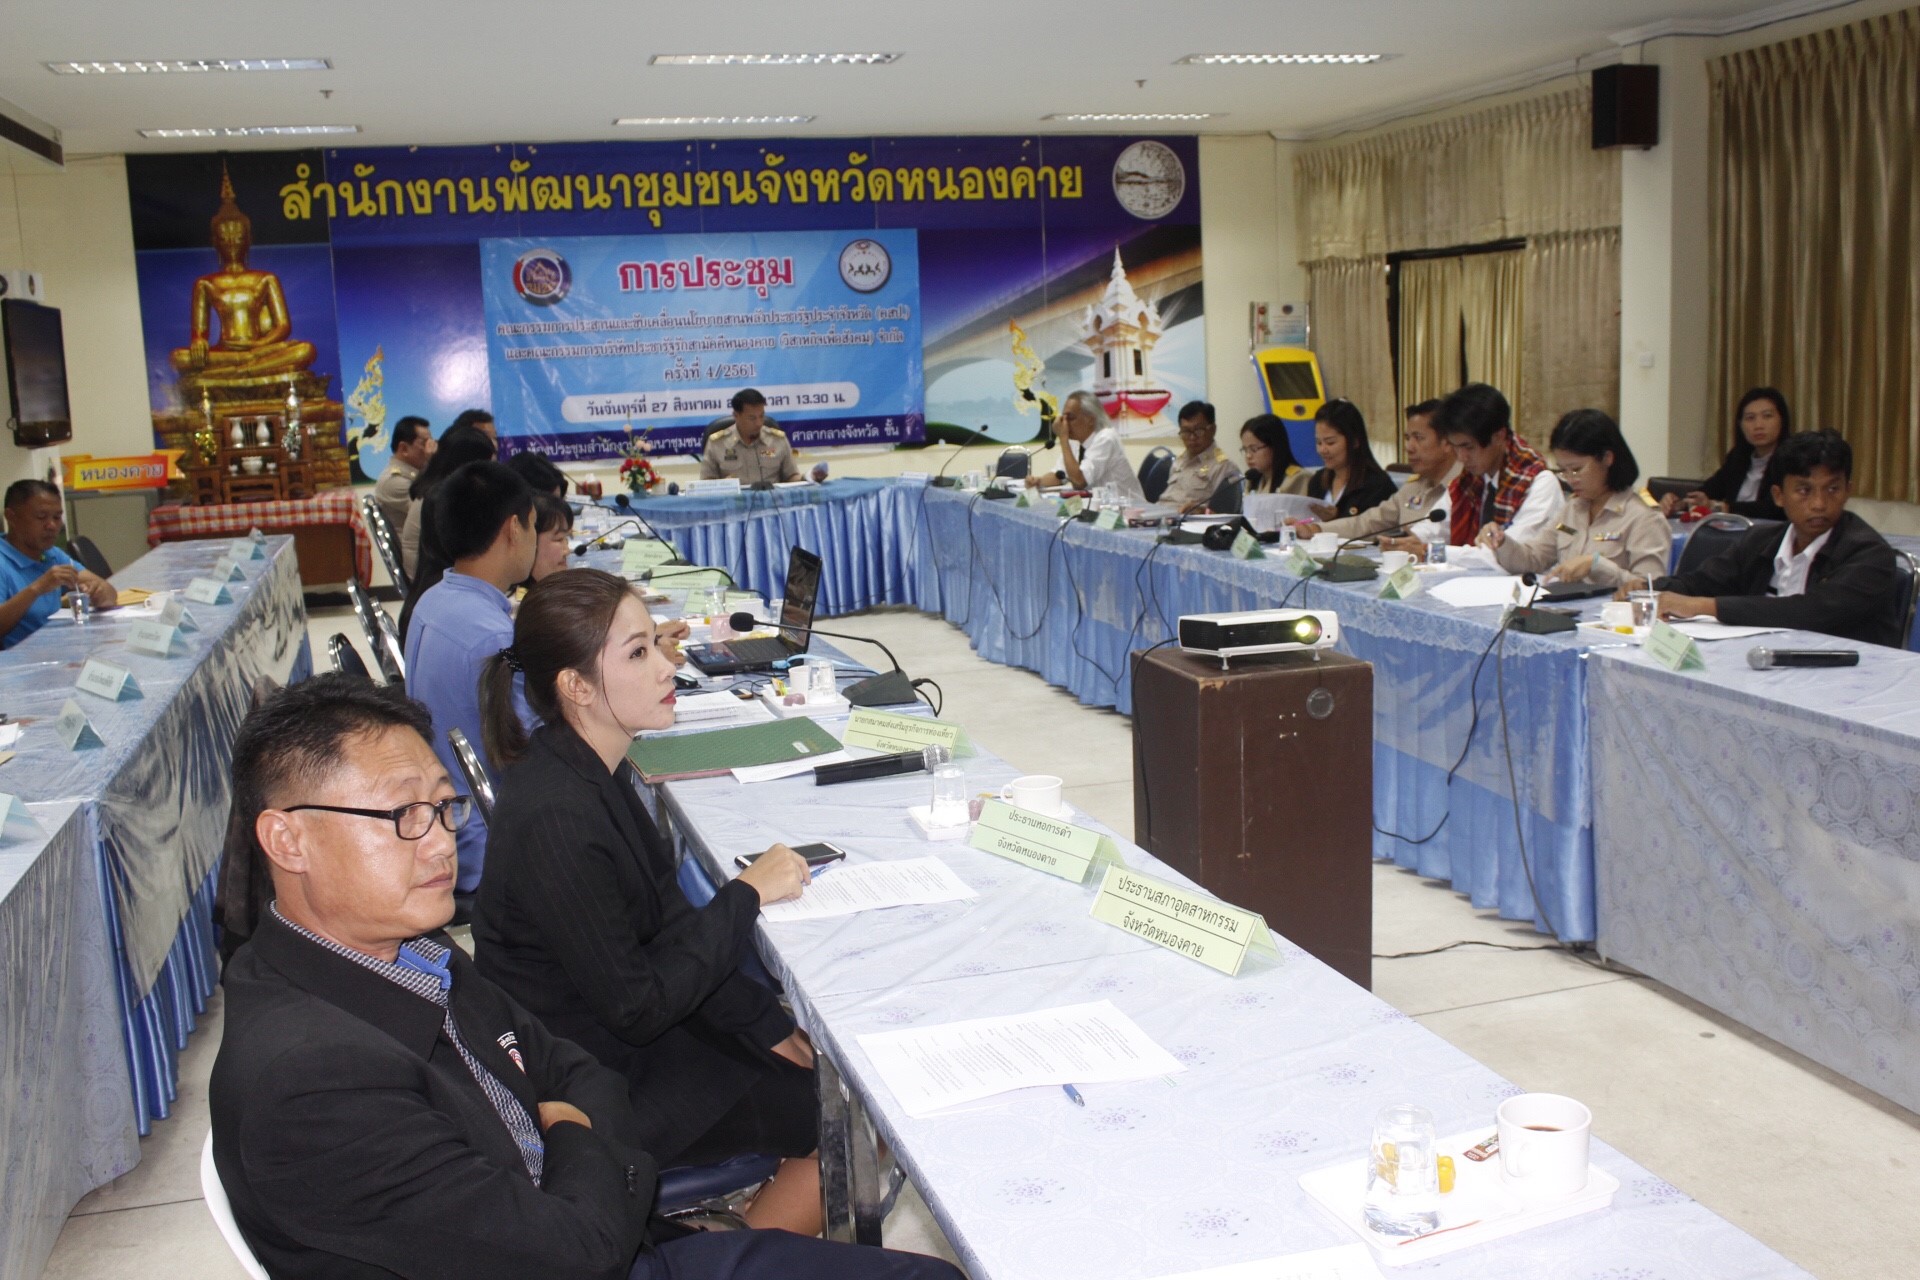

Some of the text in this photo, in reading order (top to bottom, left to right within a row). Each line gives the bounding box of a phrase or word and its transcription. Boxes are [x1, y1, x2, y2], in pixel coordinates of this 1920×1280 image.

[278, 152, 1084, 228] สำนักงานพัฒนาชุมชนจังหวัดหนองคาย
[618, 255, 794, 297] การประชุม
[664, 356, 757, 381] ครั้งที่ 4/2561
[586, 396, 647, 417] วันจันทร์ที่
[652, 401, 668, 413] 27
[673, 396, 722, 412] สิงหาคม
[796, 393, 829, 405] 13.30
[834, 393, 846, 404] น.
[792, 424, 879, 442] ศาลากลางจังหวัด
[81, 464, 164, 481] หนองคาย
[1008, 809, 1072, 839] ประธานหอการค้า
[997, 836, 1057, 866] จังหวัดหนองคาย
[1118, 875, 1240, 934] ประธานสภาอุตสาหกรรม
[1122, 910, 1205, 959] จังหวัดหนองคาย
